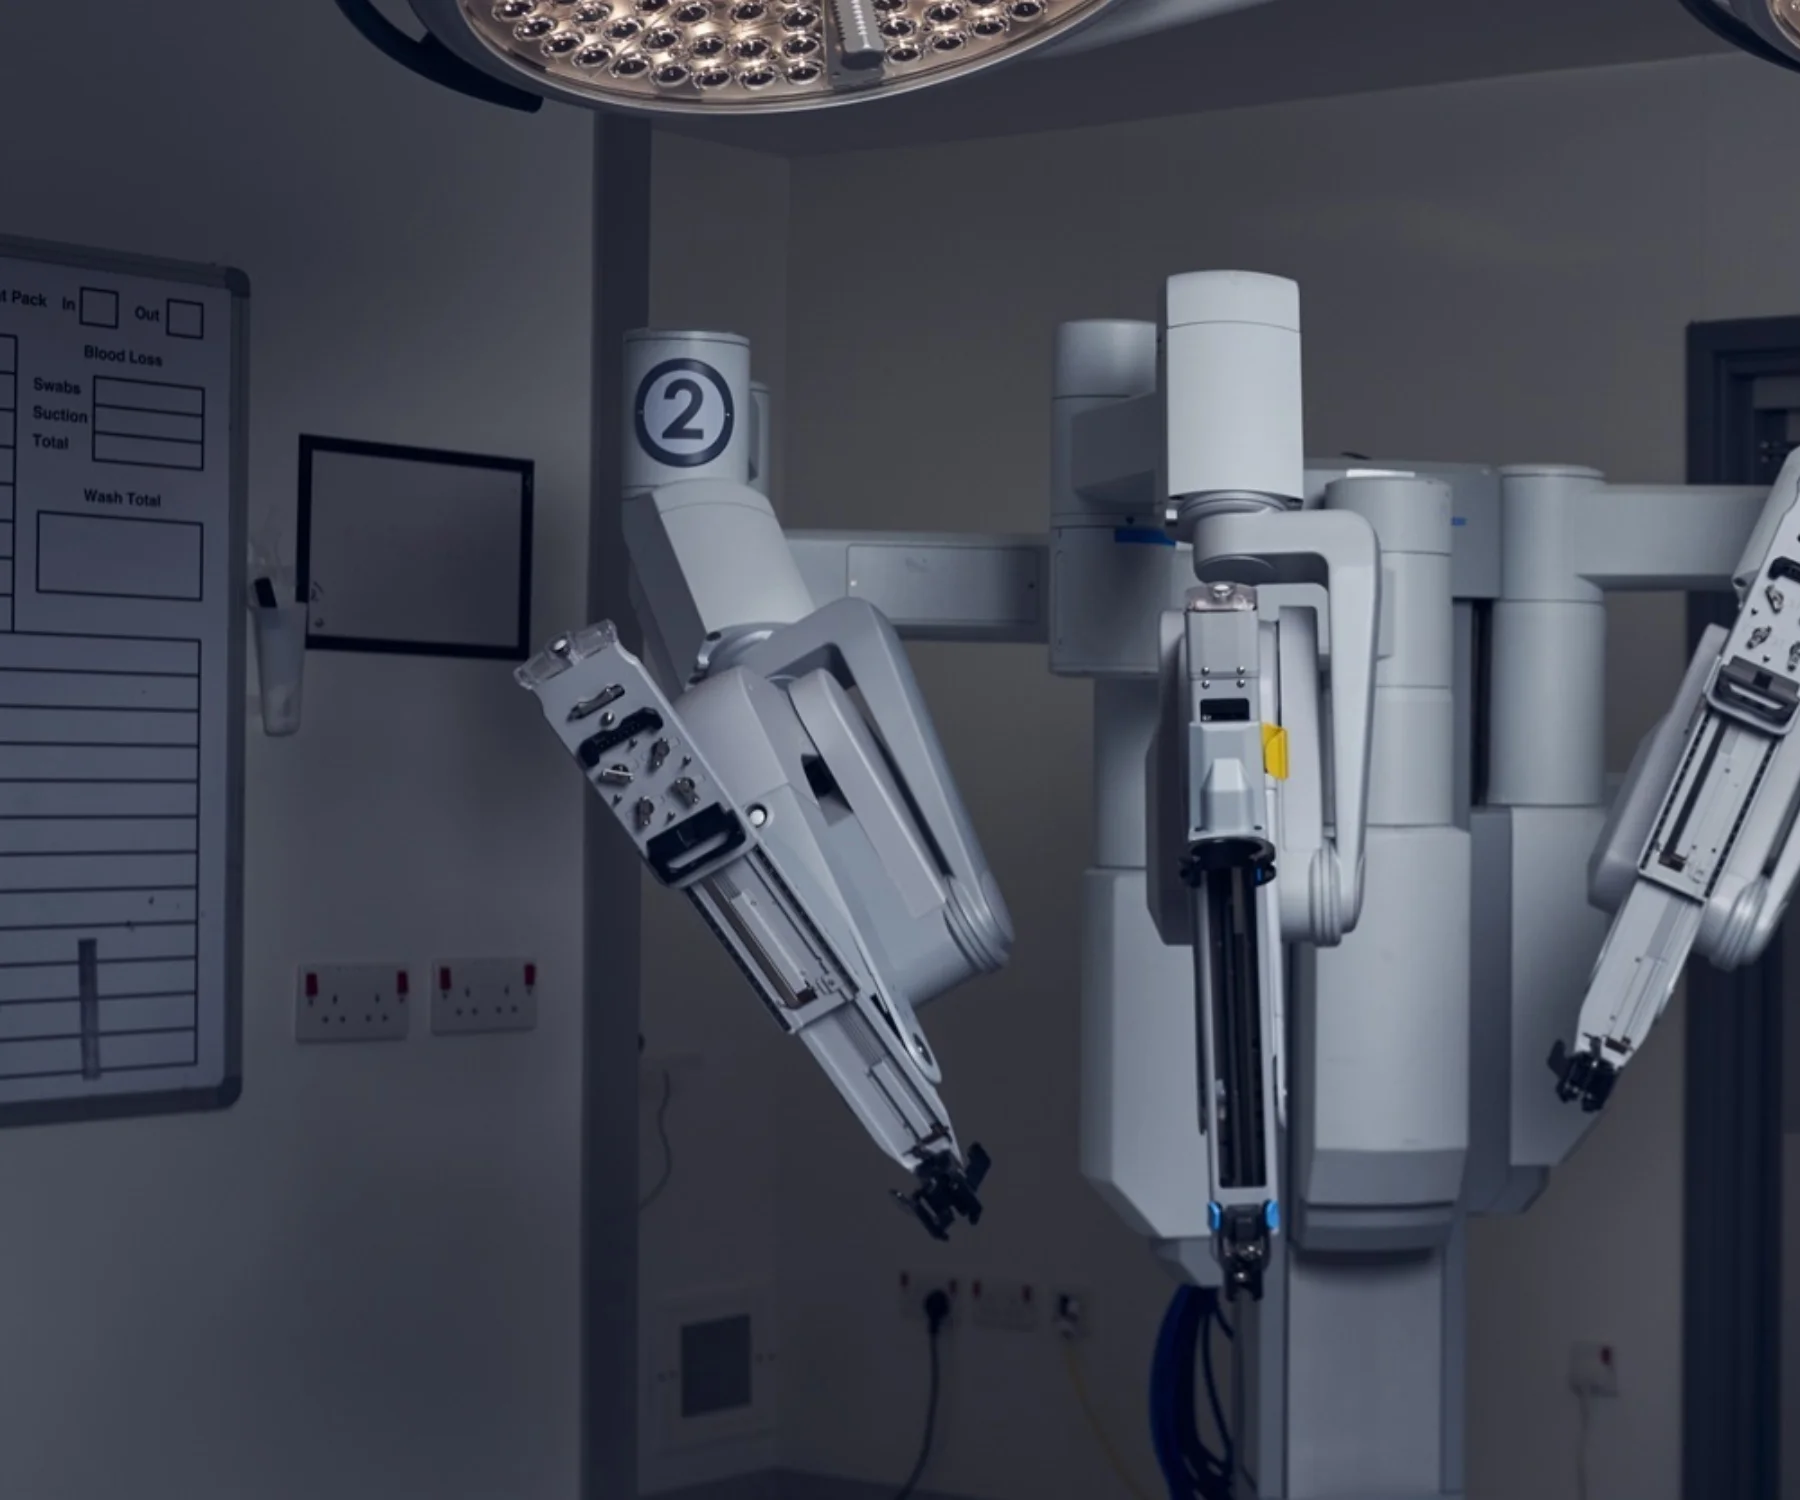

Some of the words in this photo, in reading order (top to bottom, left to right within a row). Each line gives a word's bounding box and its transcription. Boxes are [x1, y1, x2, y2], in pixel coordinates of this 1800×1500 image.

[12, 289, 47, 308] Pack
[62, 296, 76, 312] In
[134, 305, 160, 322] Out
[84, 344, 126, 363] Blood
[129, 349, 163, 367] Loss
[33, 377, 81, 396] Swabs
[33, 405, 88, 424] Suction
[661, 378, 705, 440] 2
[32, 433, 69, 451] Total
[84, 488, 123, 505] Wash
[126, 492, 161, 508] Total
